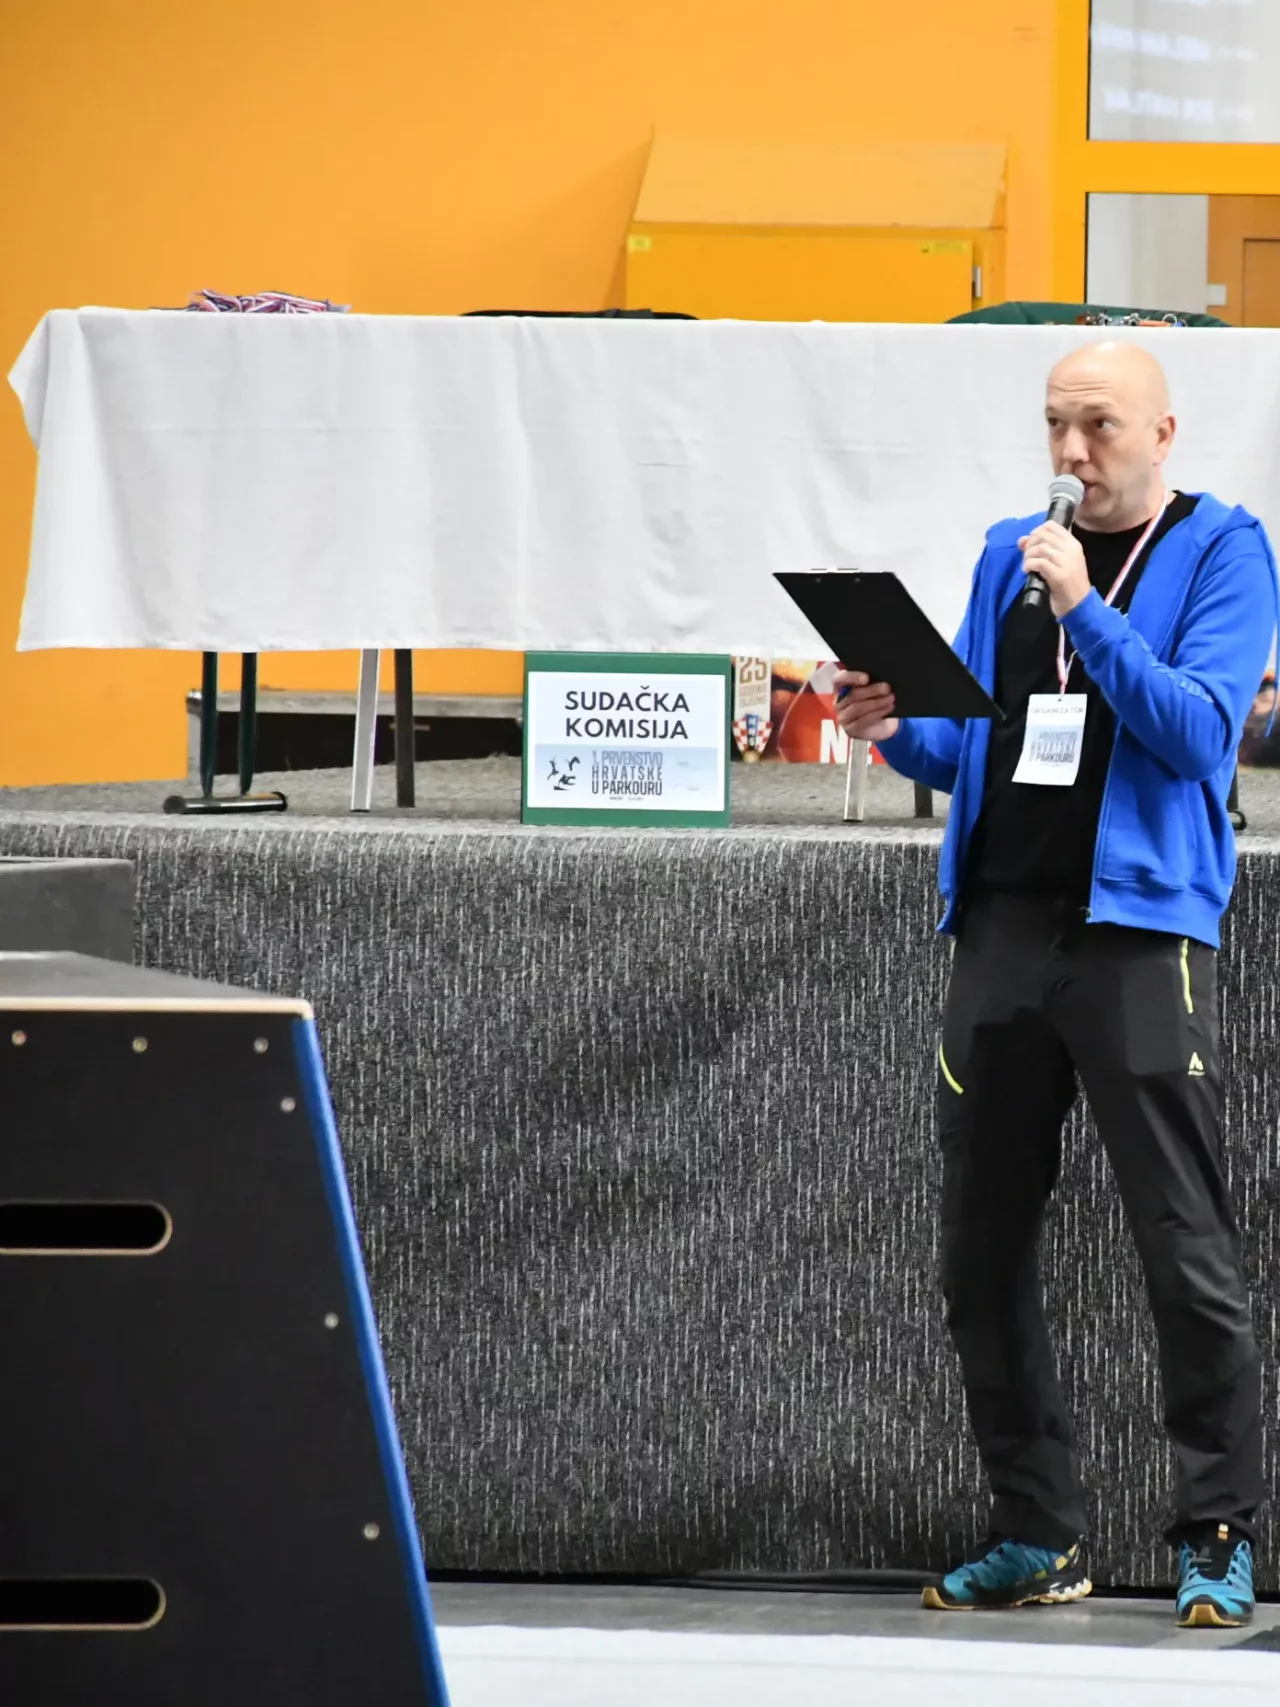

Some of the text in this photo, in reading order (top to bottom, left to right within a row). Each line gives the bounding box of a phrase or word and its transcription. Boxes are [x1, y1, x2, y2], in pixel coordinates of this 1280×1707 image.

[564, 685, 690, 713] SUDAČKA
[565, 717, 689, 740] KOMISIJA
[601, 750, 663, 767] PRVENSTVO
[591, 765, 663, 781] HRVATSKE
[591, 780, 663, 796] U PARKOURU
